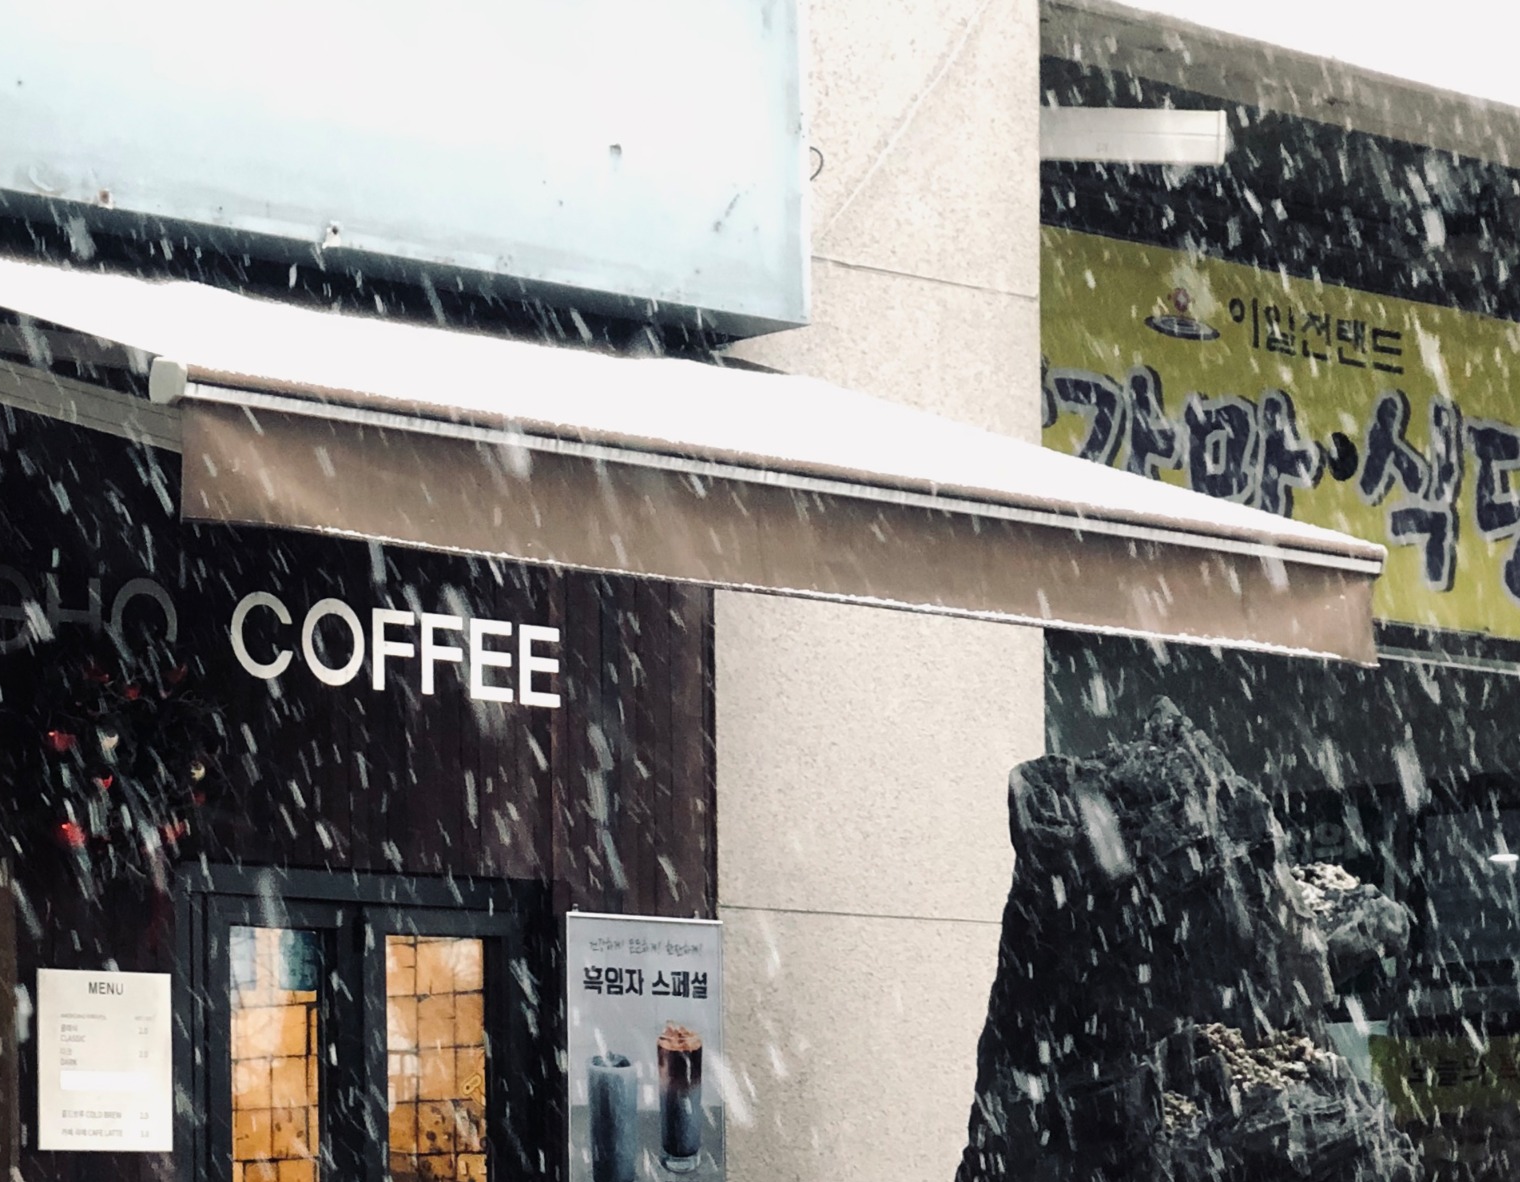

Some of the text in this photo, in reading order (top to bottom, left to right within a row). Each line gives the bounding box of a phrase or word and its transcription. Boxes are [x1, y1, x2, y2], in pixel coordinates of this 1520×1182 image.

[231, 590, 562, 709] COFFEE
[88, 981, 124, 996] MENU
[583, 966, 708, 999] 흑임자 스페셜
